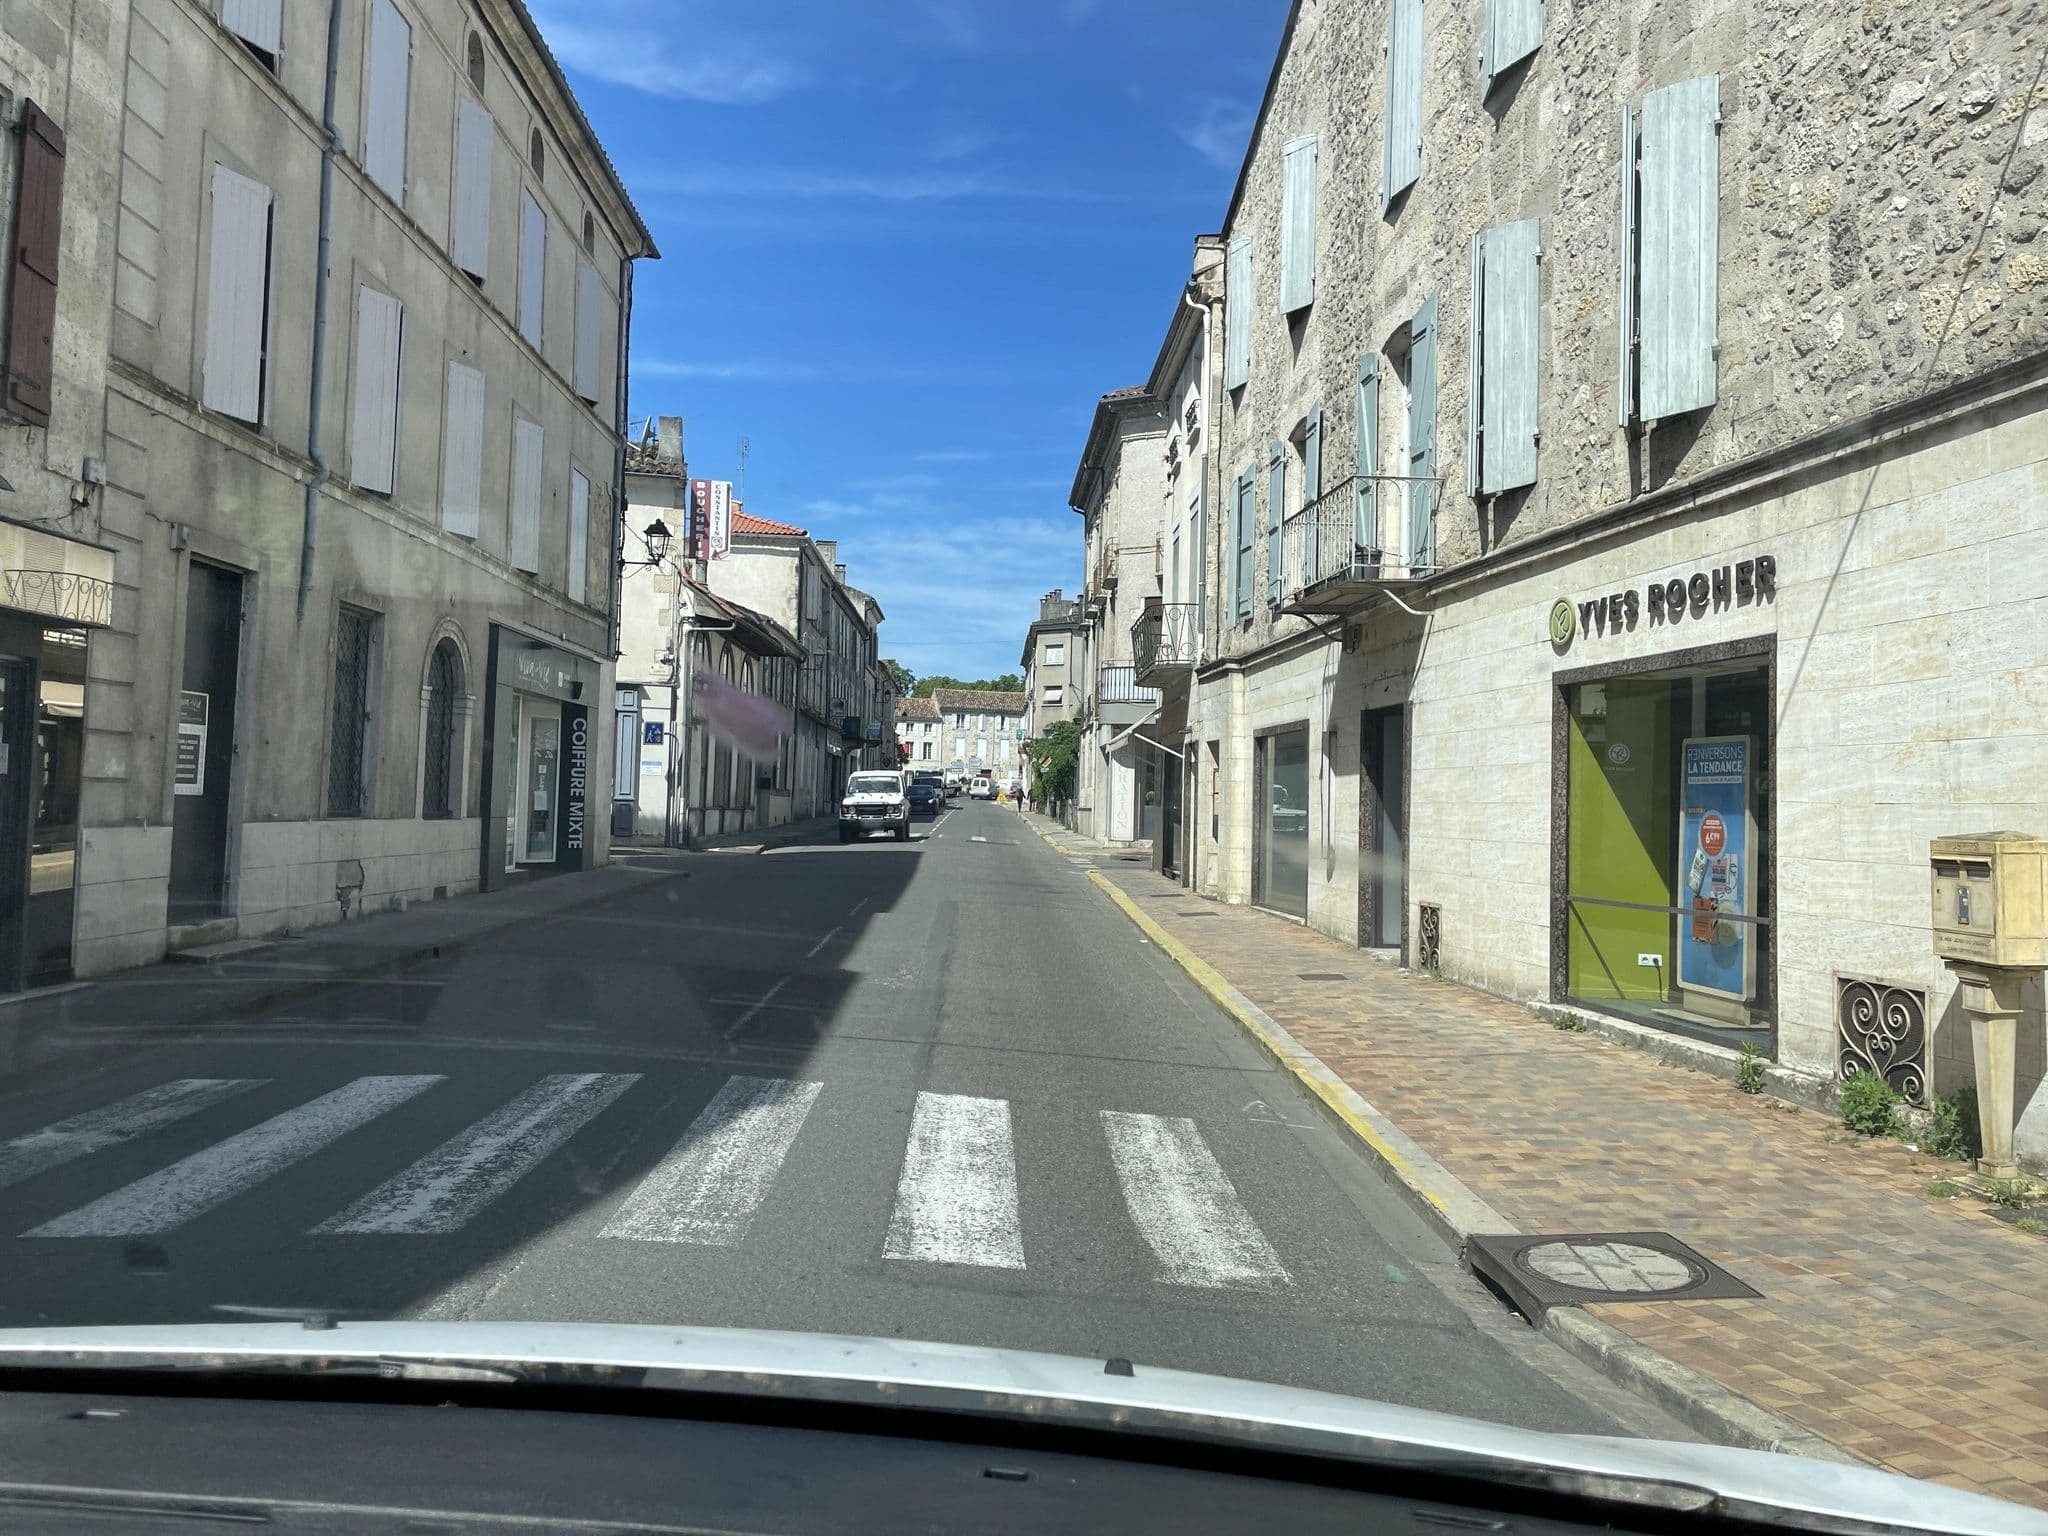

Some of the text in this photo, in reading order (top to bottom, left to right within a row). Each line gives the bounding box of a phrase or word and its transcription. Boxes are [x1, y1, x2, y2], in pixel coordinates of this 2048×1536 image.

[695, 481, 706, 558] BOUCHERIE
[1578, 555, 1776, 634] YVES ROCHER
[568, 718, 587, 849] COIFFURE MIXTE
[1687, 762, 1698, 774] LA
